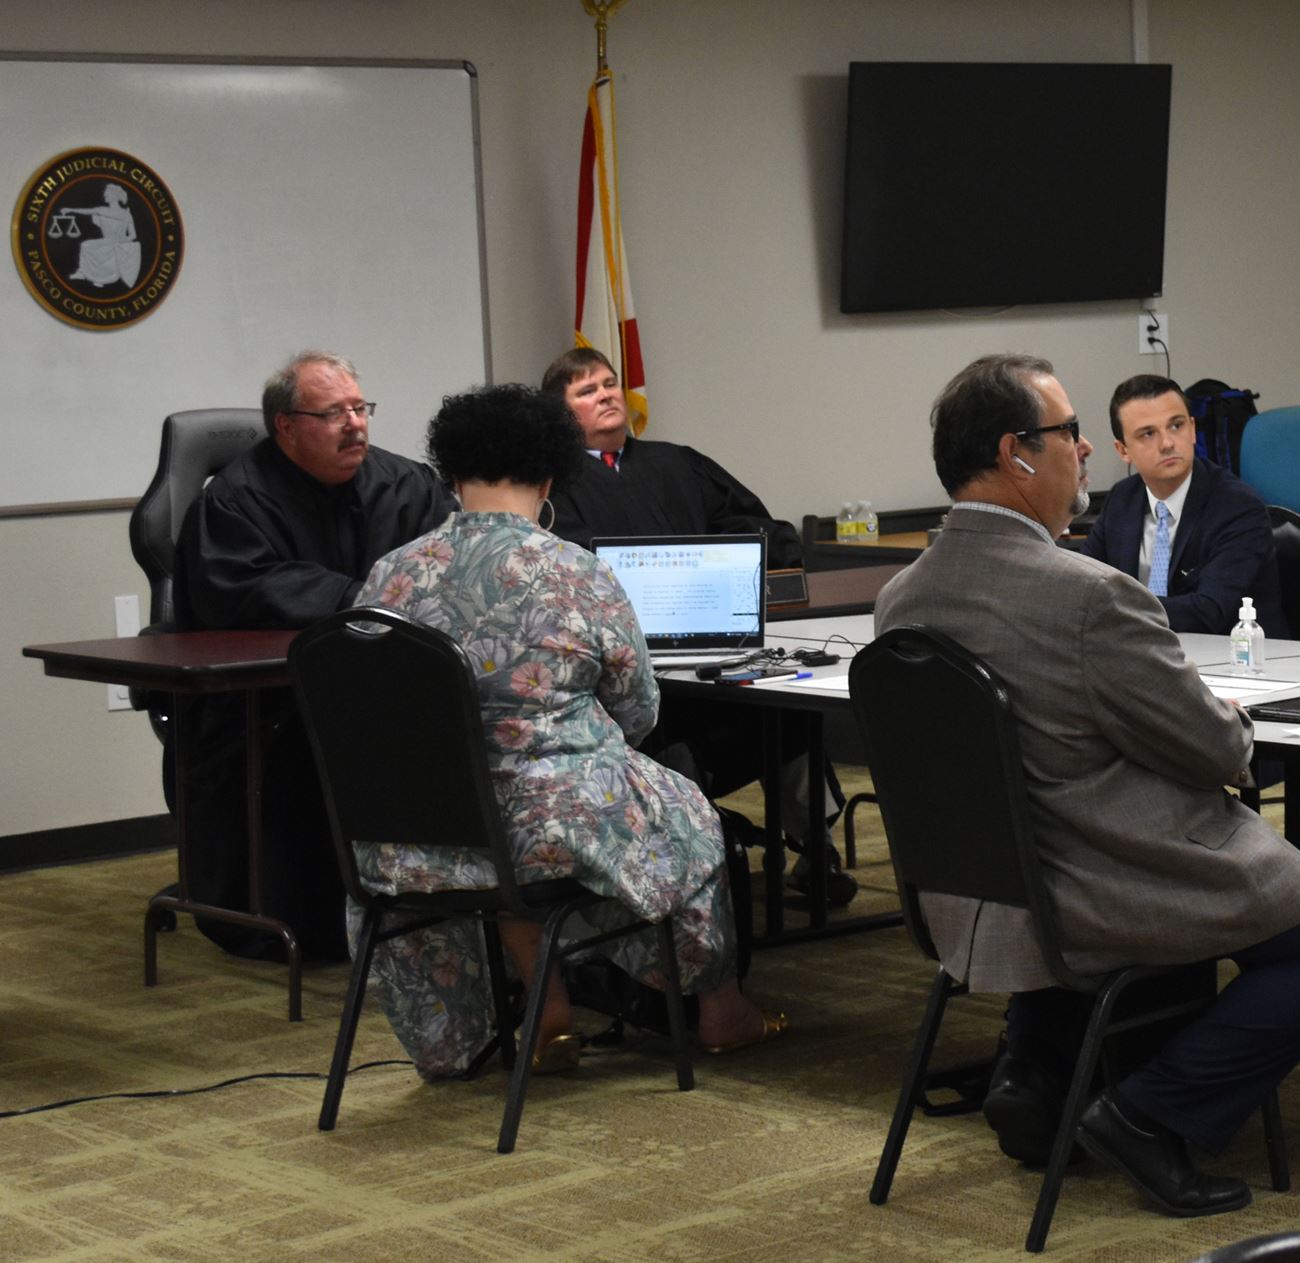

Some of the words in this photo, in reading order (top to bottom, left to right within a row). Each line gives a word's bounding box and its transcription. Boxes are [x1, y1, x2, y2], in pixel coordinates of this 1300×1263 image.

[27, 177, 57, 223] SIXTH
[56, 157, 127, 182] JUDICIAL
[130, 168, 176, 226] CIRCUIT
[28, 250, 62, 300] PASCO
[63, 299, 132, 320] COUNTY,
[133, 251, 176, 312] FLORIDA
